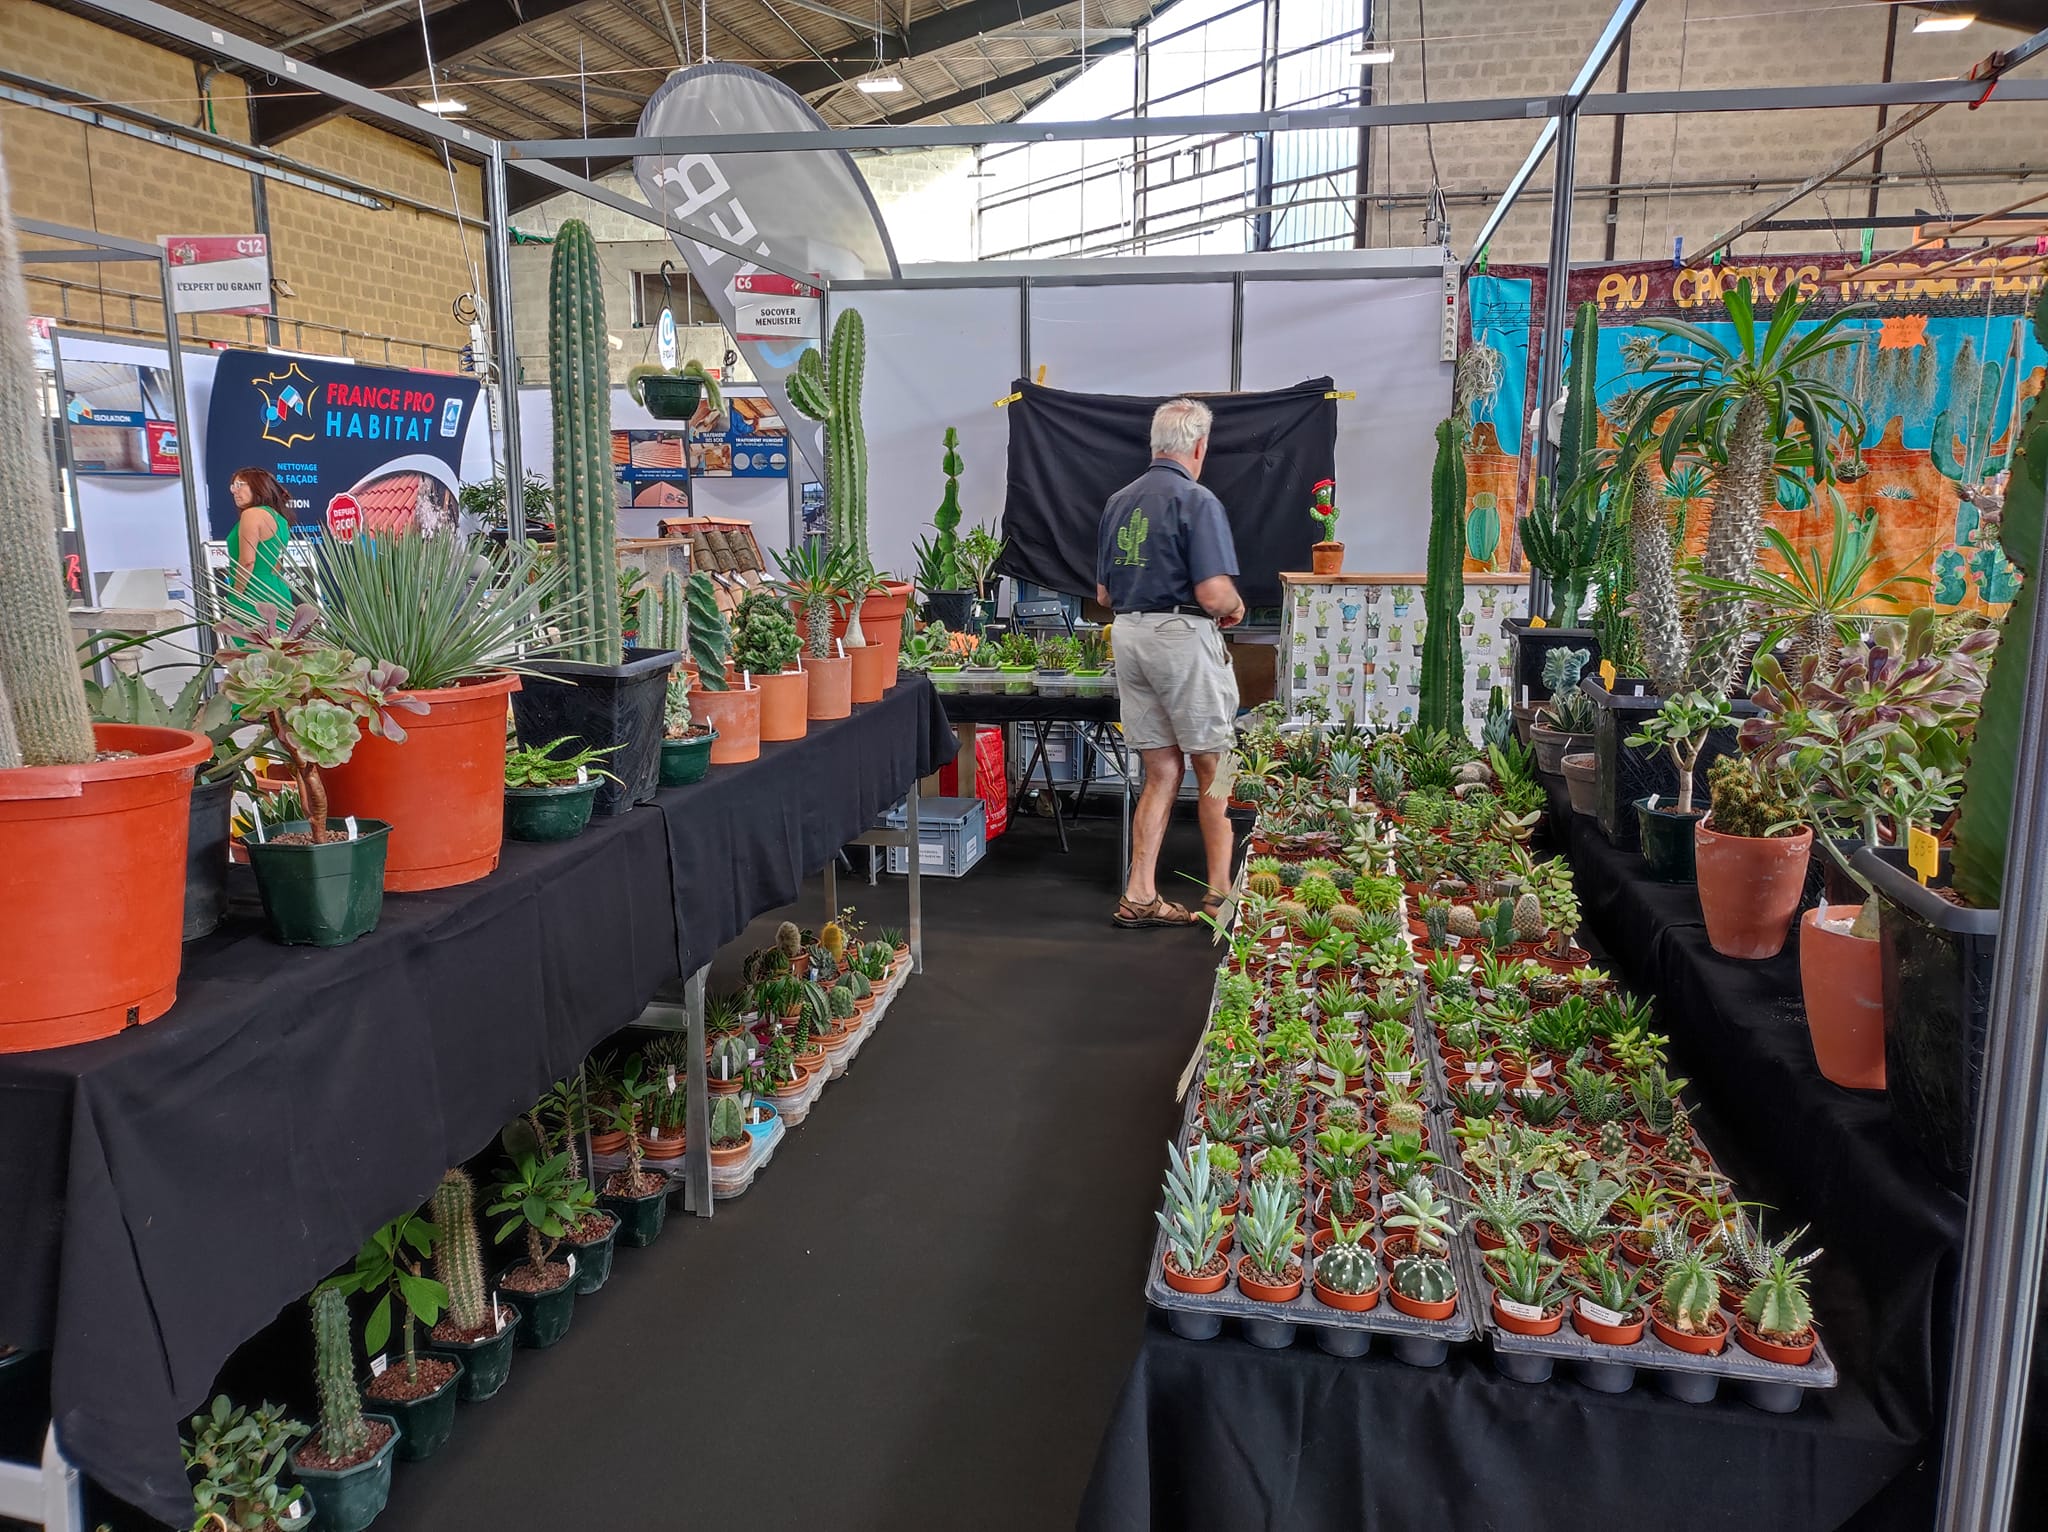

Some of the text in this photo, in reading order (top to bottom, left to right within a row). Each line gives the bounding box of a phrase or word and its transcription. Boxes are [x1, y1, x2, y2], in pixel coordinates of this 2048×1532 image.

[236, 240, 263, 254] C12
[177, 282, 263, 291] L'EXPERT DU GRANIT
[736, 277, 752, 290] C6
[1596, 272, 1649, 312] AU
[1673, 265, 1821, 308] CACTUS
[760, 308, 796, 316] SOCOVER
[755, 317, 801, 326] MENUISERIE
[326, 382, 435, 413] FRANCE PRO
[326, 410, 433, 442] HABITAT
[277, 463, 318, 472] NETTOYAGE
[286, 475, 318, 486] FAÇADE
[333, 507, 356, 518] DEPUIS
